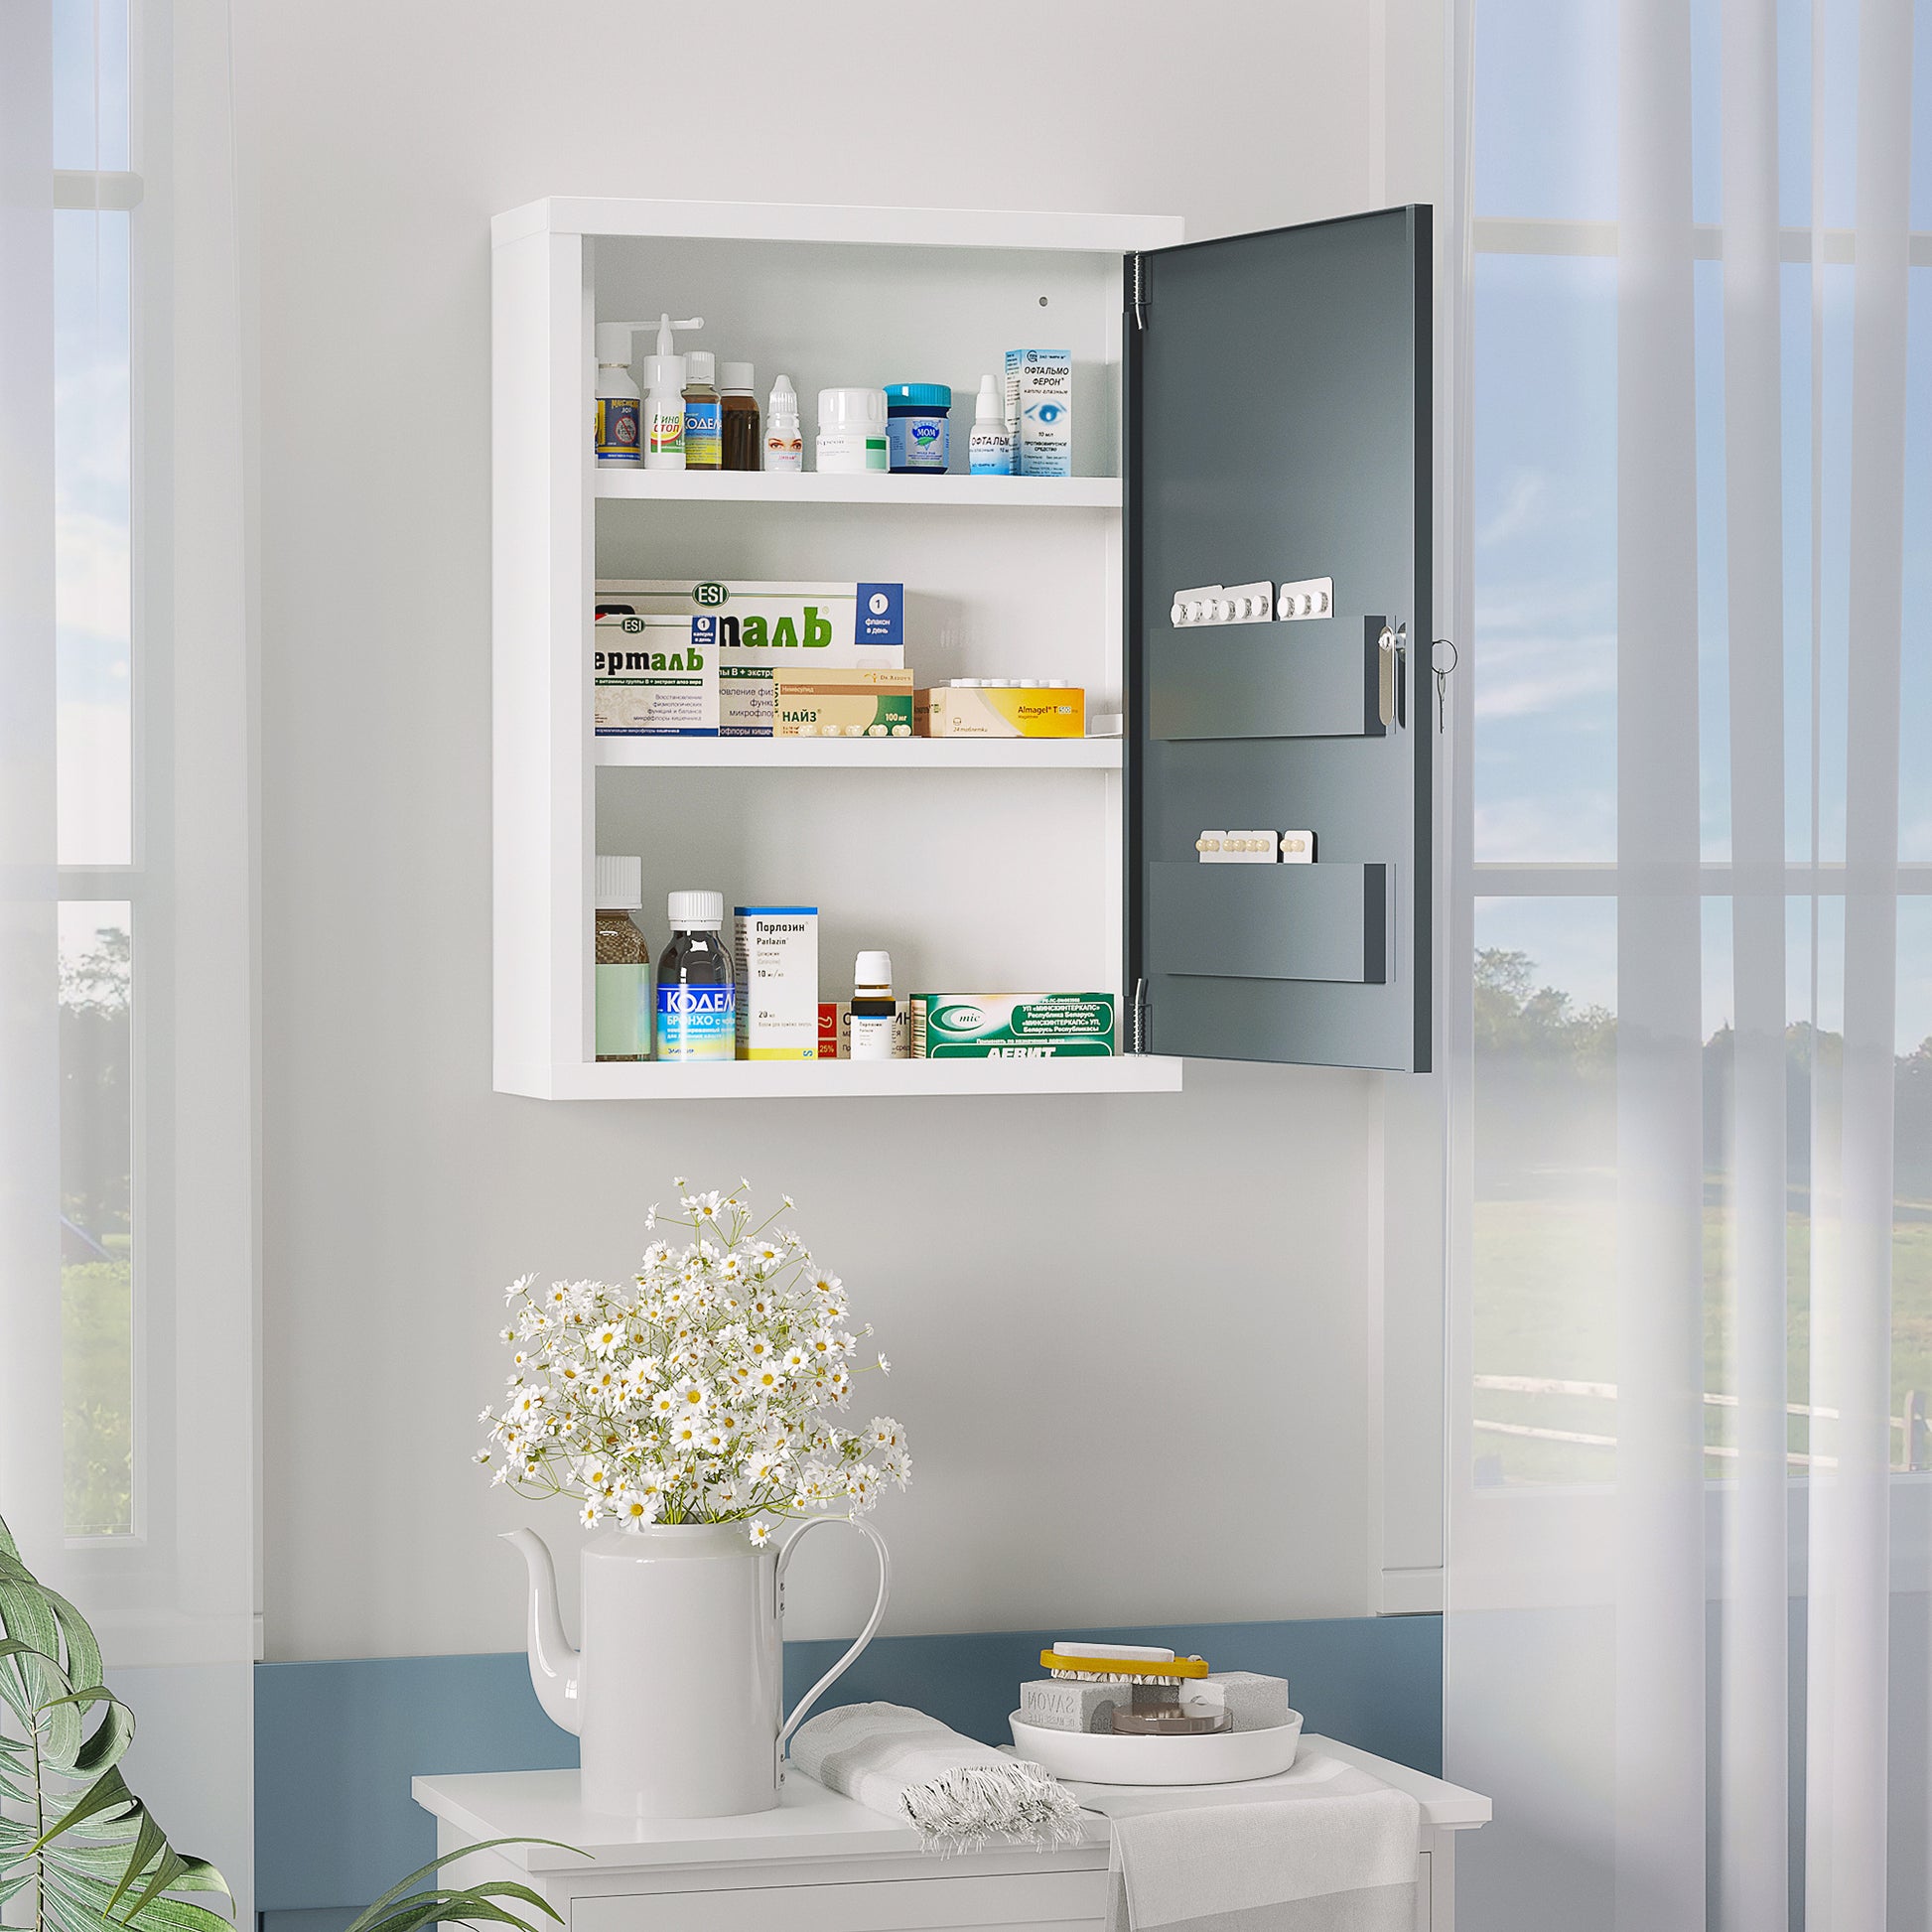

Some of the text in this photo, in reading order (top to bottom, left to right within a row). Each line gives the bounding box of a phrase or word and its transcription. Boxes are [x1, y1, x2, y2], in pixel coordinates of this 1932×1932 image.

[1025, 366, 1069, 375] ОФТАЛЬМО
[698, 588, 724, 604] ESI
[875, 599, 881, 609] 1
[623, 620, 642, 632] ESI
[701, 620, 706, 628] 1
[782, 709, 817, 722] НАЙЗ
[1018, 706, 1048, 715] Almagel
[885, 713, 898, 722] 100
[757, 921, 805, 934] Парлазин
[667, 1015, 714, 1026] БРНХО
[987, 1046, 1056, 1058] АЕВИТ
